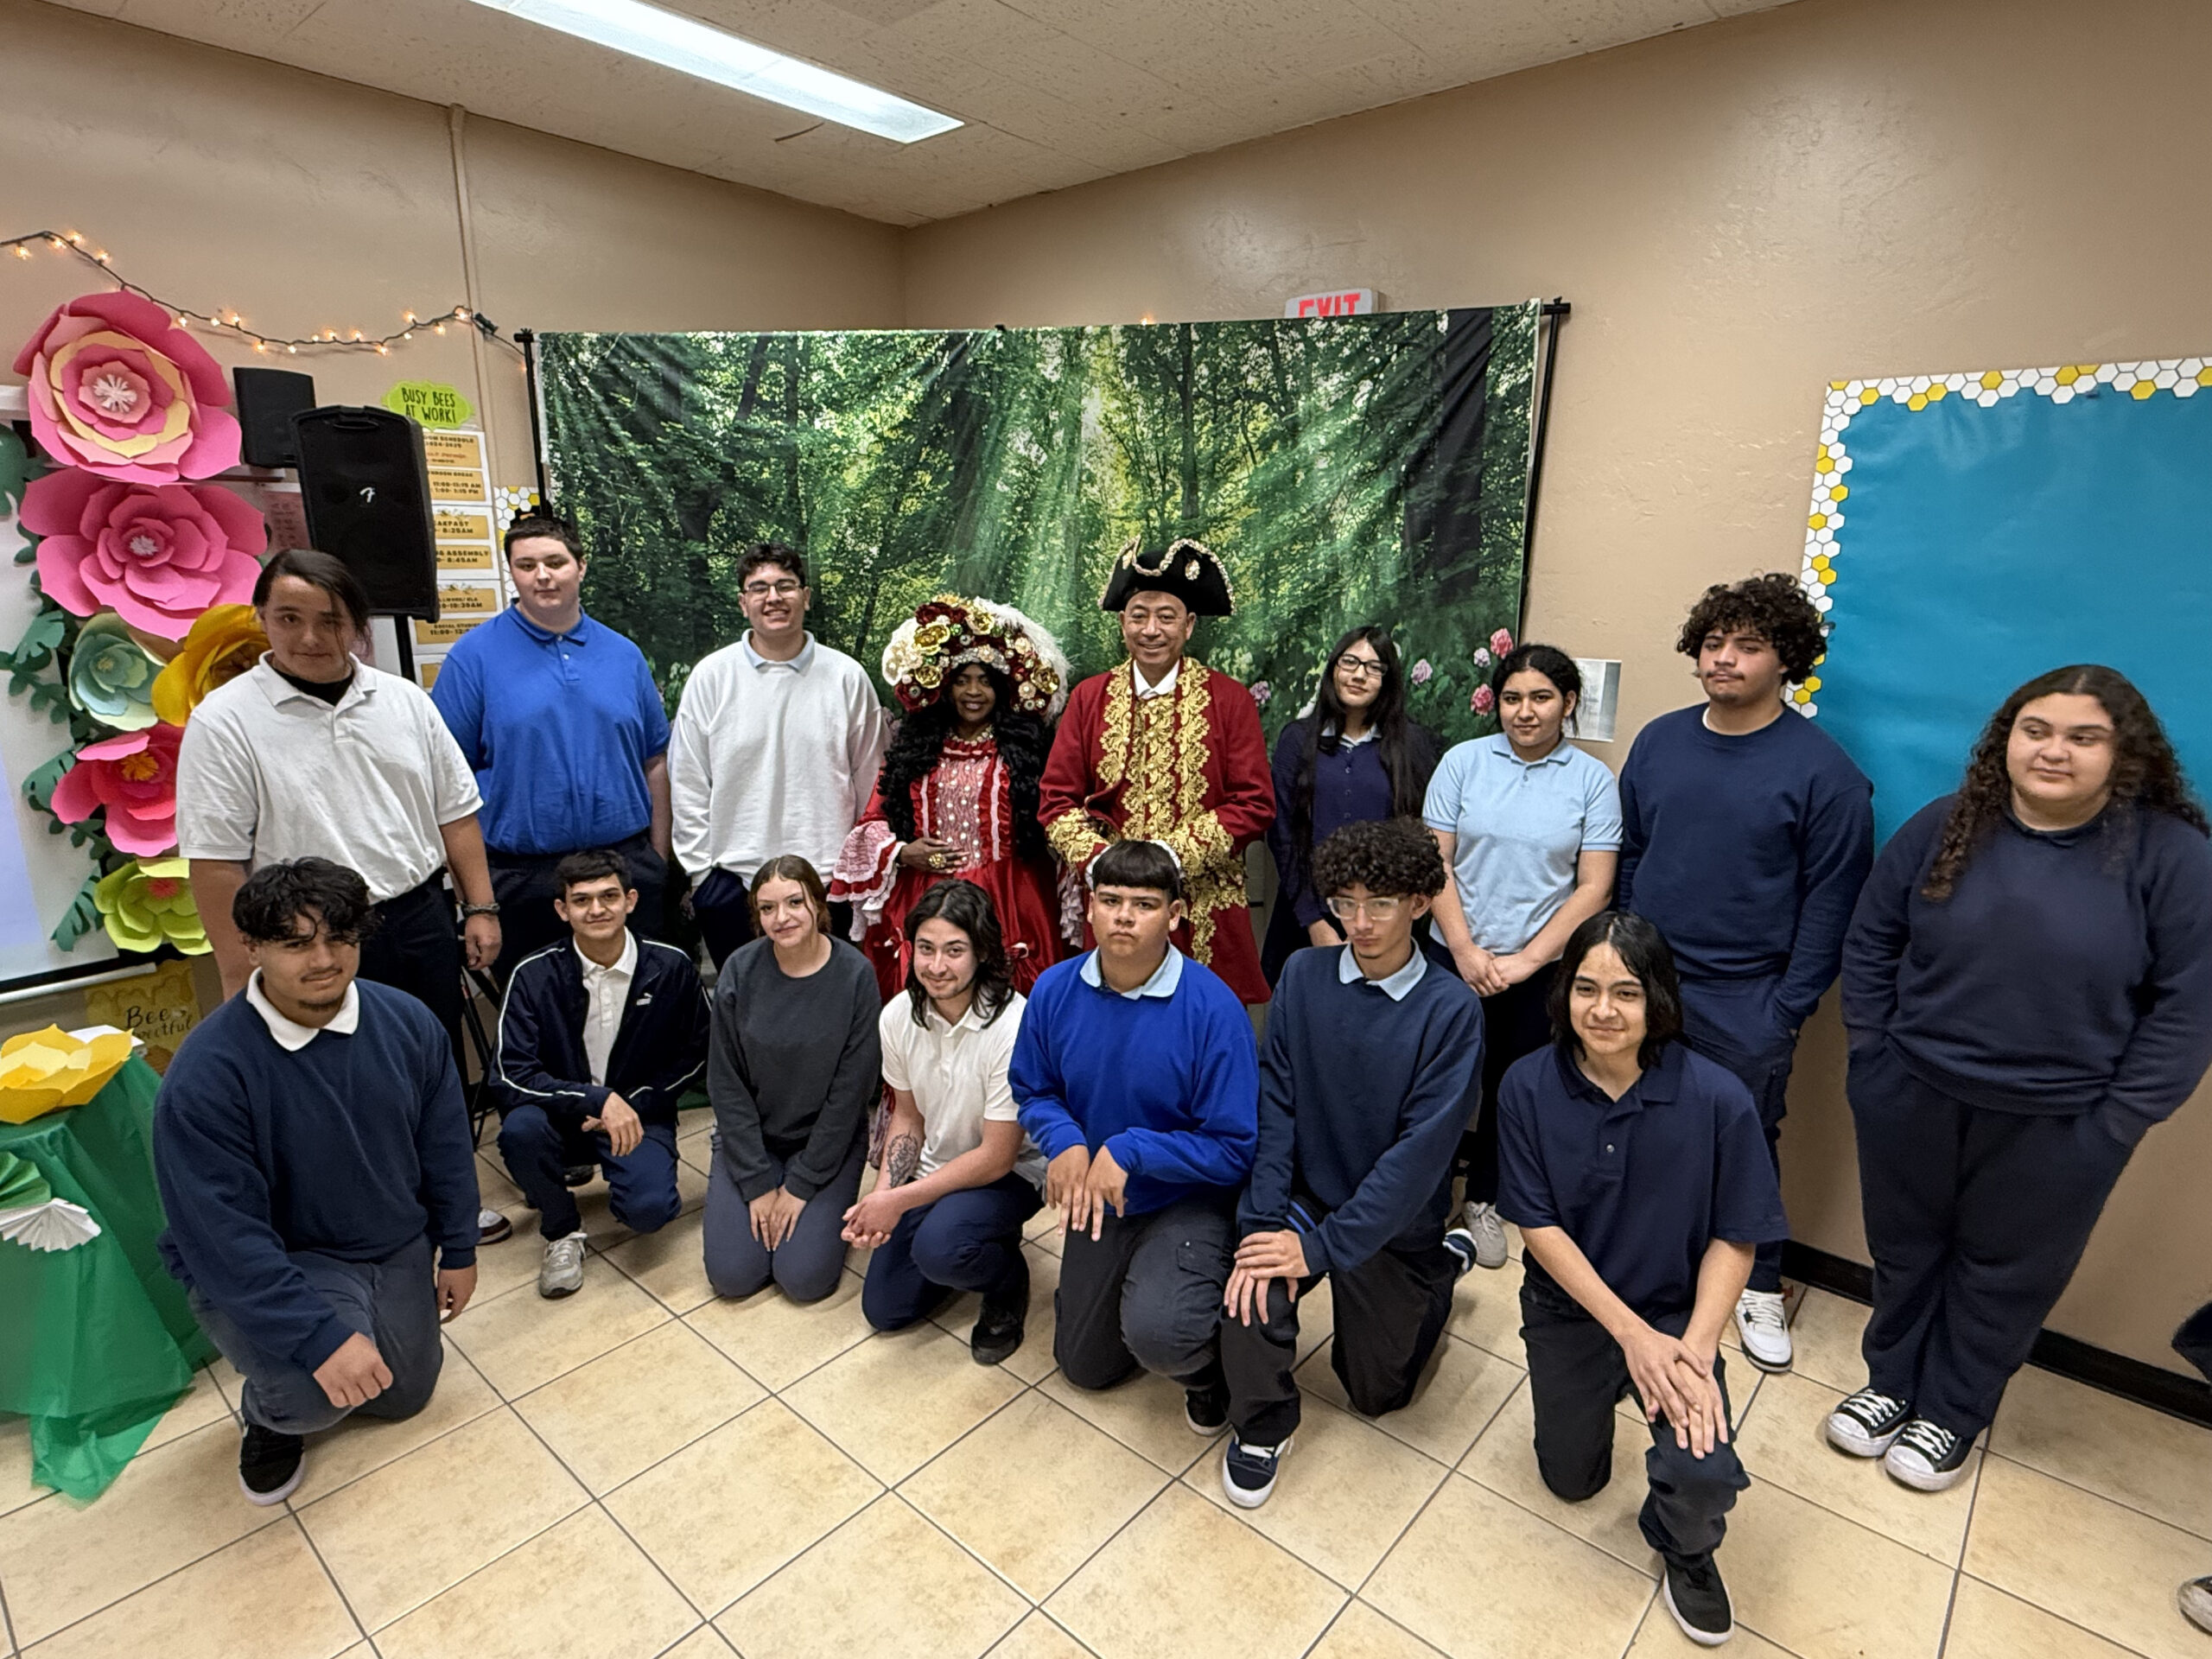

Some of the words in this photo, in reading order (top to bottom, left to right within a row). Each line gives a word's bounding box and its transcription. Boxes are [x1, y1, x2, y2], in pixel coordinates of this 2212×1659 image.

[401, 387, 427, 405] BUSY
[432, 391, 455, 408] BEES
[405, 404, 416, 417] AT
[125, 1005, 170, 1030] Bee
